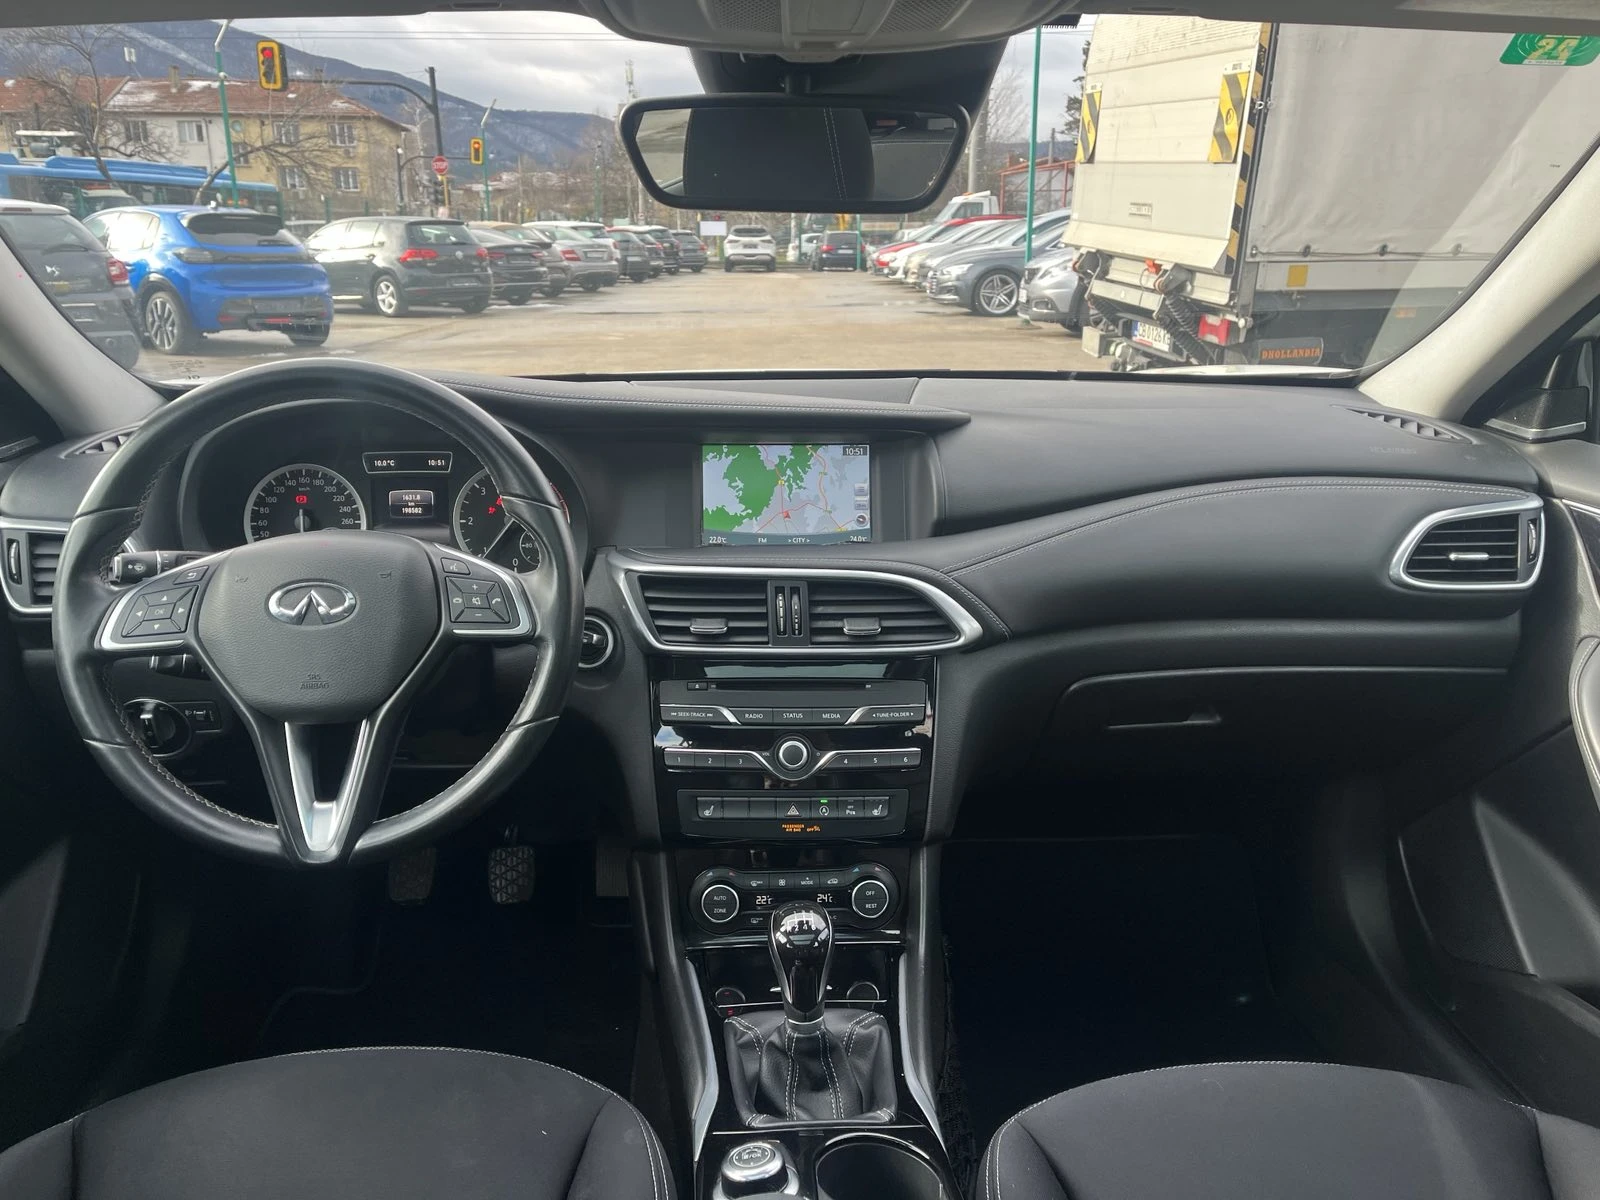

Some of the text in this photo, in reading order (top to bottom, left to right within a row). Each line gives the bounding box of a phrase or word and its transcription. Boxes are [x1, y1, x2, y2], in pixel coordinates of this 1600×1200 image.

[1261, 347, 1320, 359] DHOLLANDIA
[845, 447, 864, 456] 10:51
[284, 479, 297, 487] 140
[298, 476, 310, 484] 160
[273, 486, 285, 494] 120
[323, 485, 337, 493] 200
[480, 486, 486, 496] 3
[259, 506, 270, 514] 80
[339, 505, 352, 513] 240
[257, 519, 268, 527] 60
[467, 516, 474, 526] 2
[259, 530, 270, 538] 50
[300, 682, 330, 690] AIRBAG
